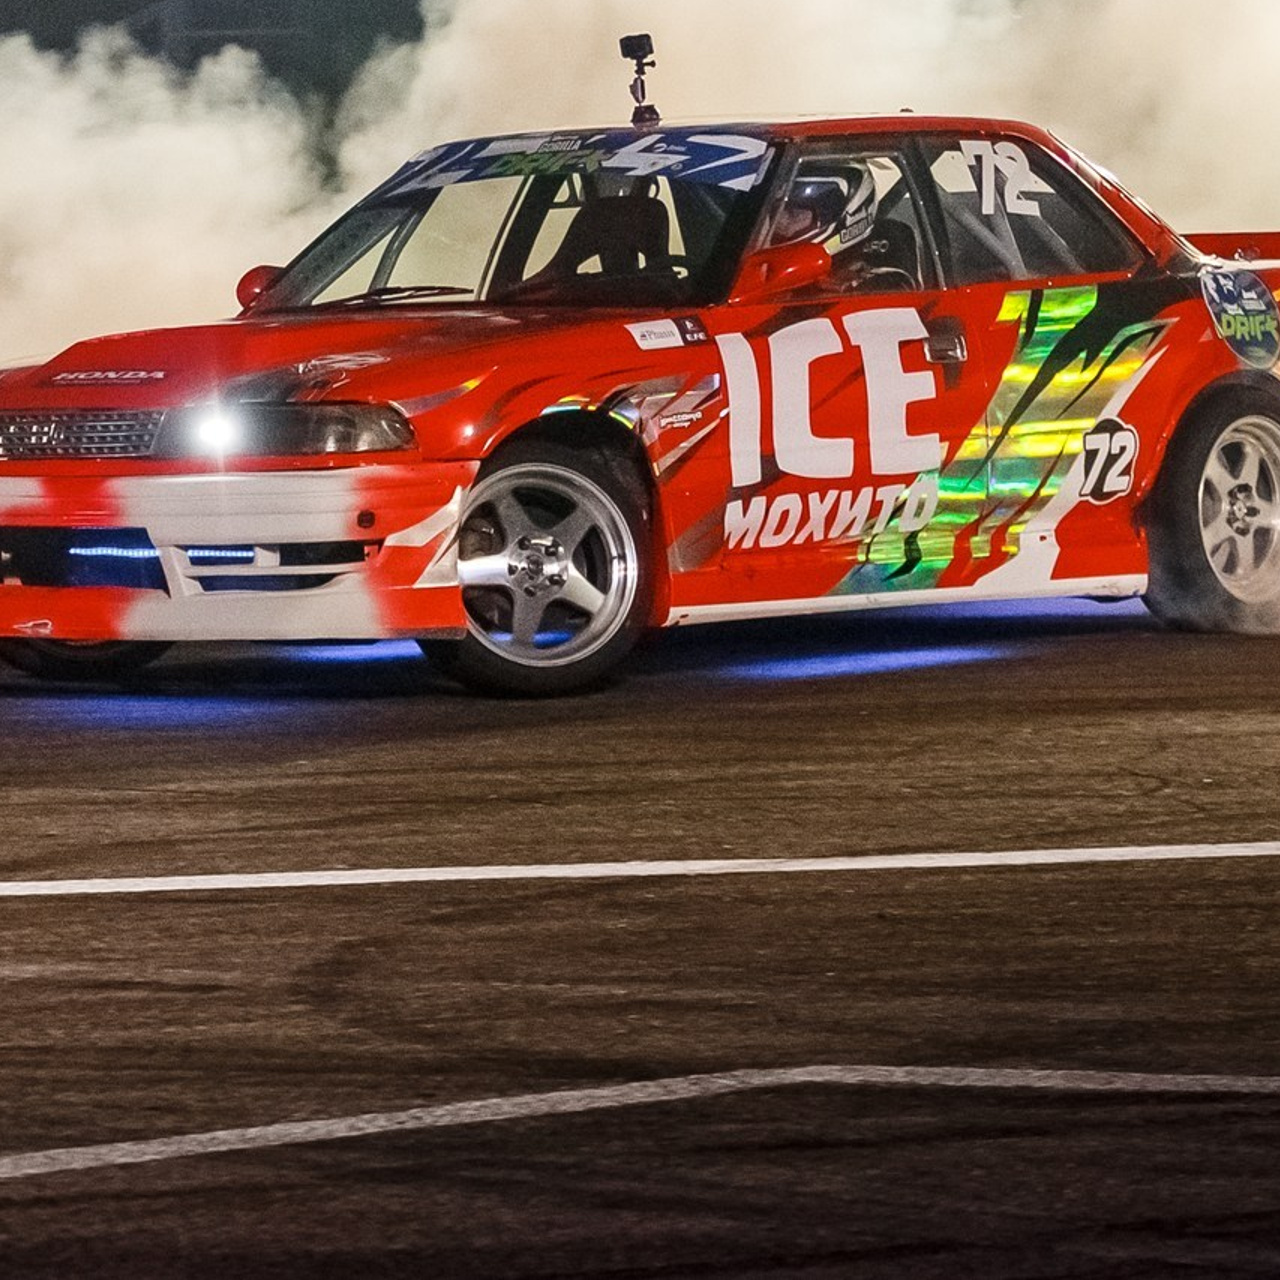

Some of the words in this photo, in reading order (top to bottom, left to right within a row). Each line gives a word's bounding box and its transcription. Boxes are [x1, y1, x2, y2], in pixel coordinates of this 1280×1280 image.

[960, 140, 1040, 216] 72
[1221, 312, 1278, 341] DRIFT
[52, 370, 165, 381] HONDA
[714, 307, 945, 487] ICE
[1080, 430, 1136, 495] 72
[723, 472, 939, 550] МОХИТО
